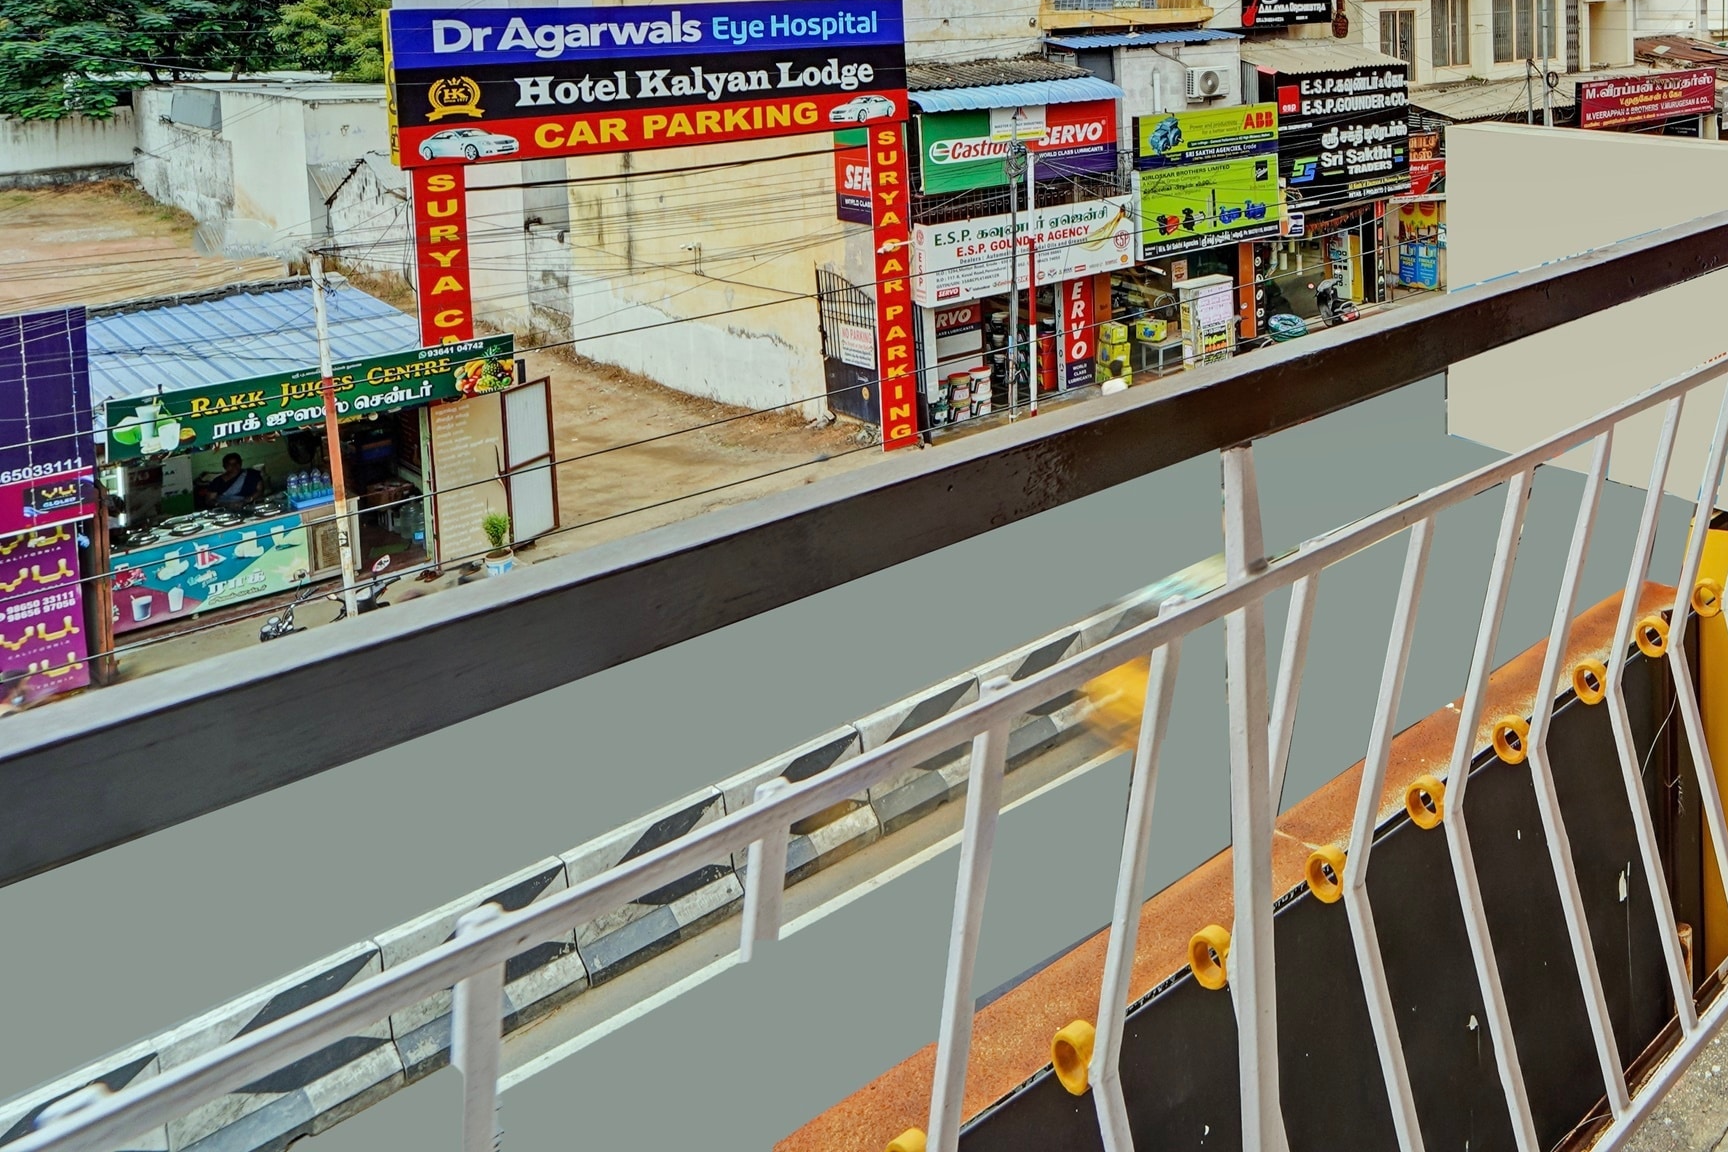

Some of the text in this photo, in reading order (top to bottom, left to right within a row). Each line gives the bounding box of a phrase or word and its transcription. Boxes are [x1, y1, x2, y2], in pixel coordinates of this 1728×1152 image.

[432, 10, 878, 59] Dr Agarwals Eye Hospital
[514, 57, 875, 107] Hotel Kalyan Lodge
[442, 88, 468, 100] HK
[1631, 104, 1659, 115] BROTHERS
[533, 100, 819, 150] CAR PARKING
[1243, 110, 1274, 131] ABB
[1038, 121, 1103, 147] SERVO
[1039, 145, 1105, 159] WORLD CLASS LUBRICANTS
[1185, 150, 1195, 158] SRI
[1195, 148, 1216, 157] SAKTHI
[1320, 150, 1344, 168] Sri
[1345, 144, 1392, 165] Sakthi
[1142, 164, 1231, 181] KIRLOSKAR BROTHERS LIMITED
[1347, 160, 1393, 176] TRADERS
[877, 131, 901, 227] SURYA
[427, 174, 464, 296] SURYA
[934, 232, 972, 247] E.S.P.
[957, 242, 986, 258] E.S.P.
[1047, 225, 1091, 245] AGENCY
[938, 287, 959, 298] SERVO
[427, 341, 484, 358] 93641 04742
[885, 305, 913, 441] PARKING
[1072, 362, 1087, 371] WORLD
[1073, 369, 1087, 377] CLASS
[190, 389, 266, 418] RAKK
[366, 357, 451, 385] CENTRE
[1067, 373, 1093, 385] LUBRICANTS
[211, 412, 261, 440] ராக்
[353, 380, 433, 411] சென்டர்
[0, 456, 82, 484] 65033111
[42, 590, 75, 606] 33111
